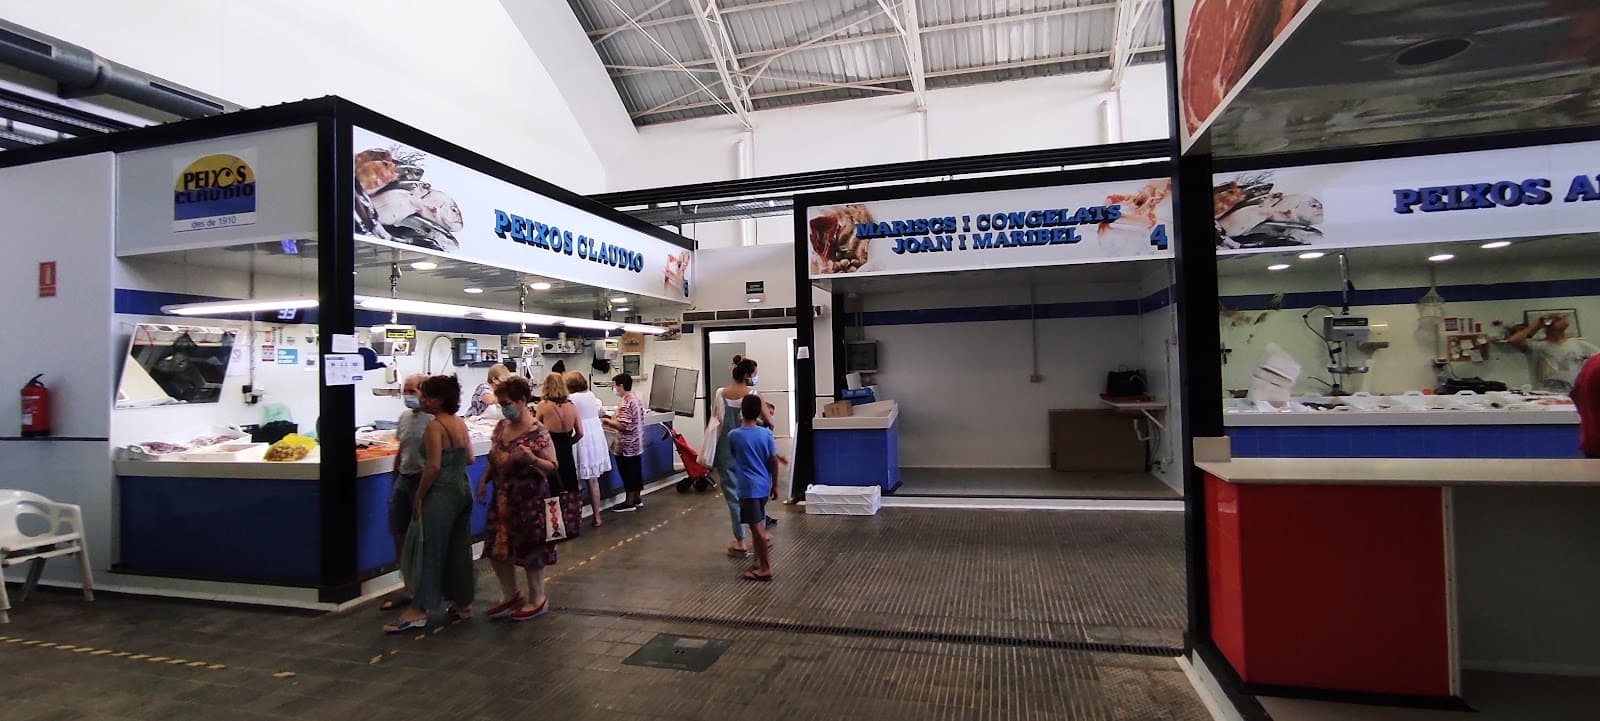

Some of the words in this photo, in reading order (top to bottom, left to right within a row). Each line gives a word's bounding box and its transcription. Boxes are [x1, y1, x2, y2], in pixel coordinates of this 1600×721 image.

[183, 166, 247, 189] PEIXOS
[175, 185, 253, 204] CLAUDIO
[1393, 178, 1552, 214] PEIXOS
[219, 216, 237, 225] 1910
[855, 216, 957, 239] MARISCS
[963, 216, 971, 232] I
[976, 205, 1122, 231] CONGELATS
[494, 209, 573, 256] PEIXOS
[577, 235, 645, 273] CLAUDIO
[892, 235, 953, 255] JOAN
[958, 234, 967, 251] I
[972, 227, 1082, 250] MARIBEL
[1150, 224, 1168, 251] 4
